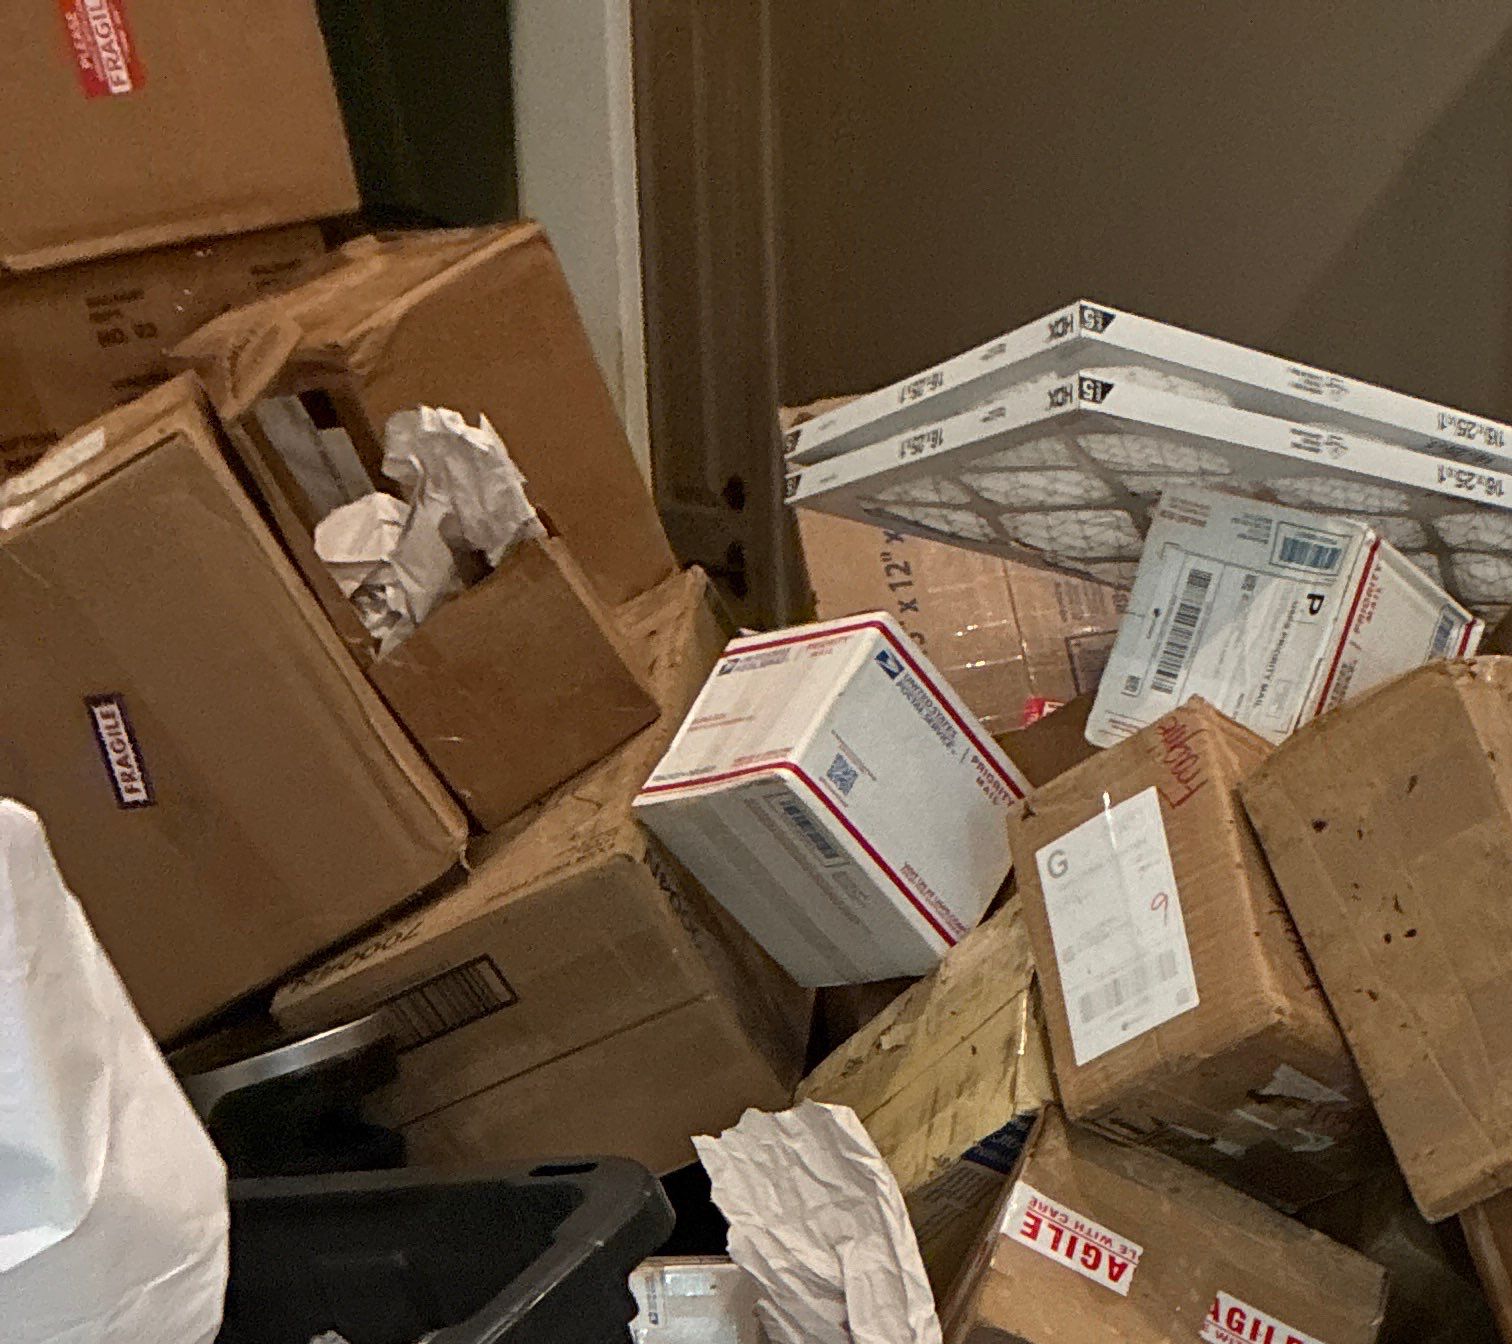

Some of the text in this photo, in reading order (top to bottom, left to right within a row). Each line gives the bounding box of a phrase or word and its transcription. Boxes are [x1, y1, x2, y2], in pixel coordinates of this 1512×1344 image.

[1307, 592, 1326, 616] P
[98, 708, 143, 795] FRAGILE
[1047, 850, 1069, 879] G
[1029, 1196, 1069, 1224] CARE
[1020, 1211, 1129, 1283] AGILE
[1074, 1221, 1113, 1248] WITH
